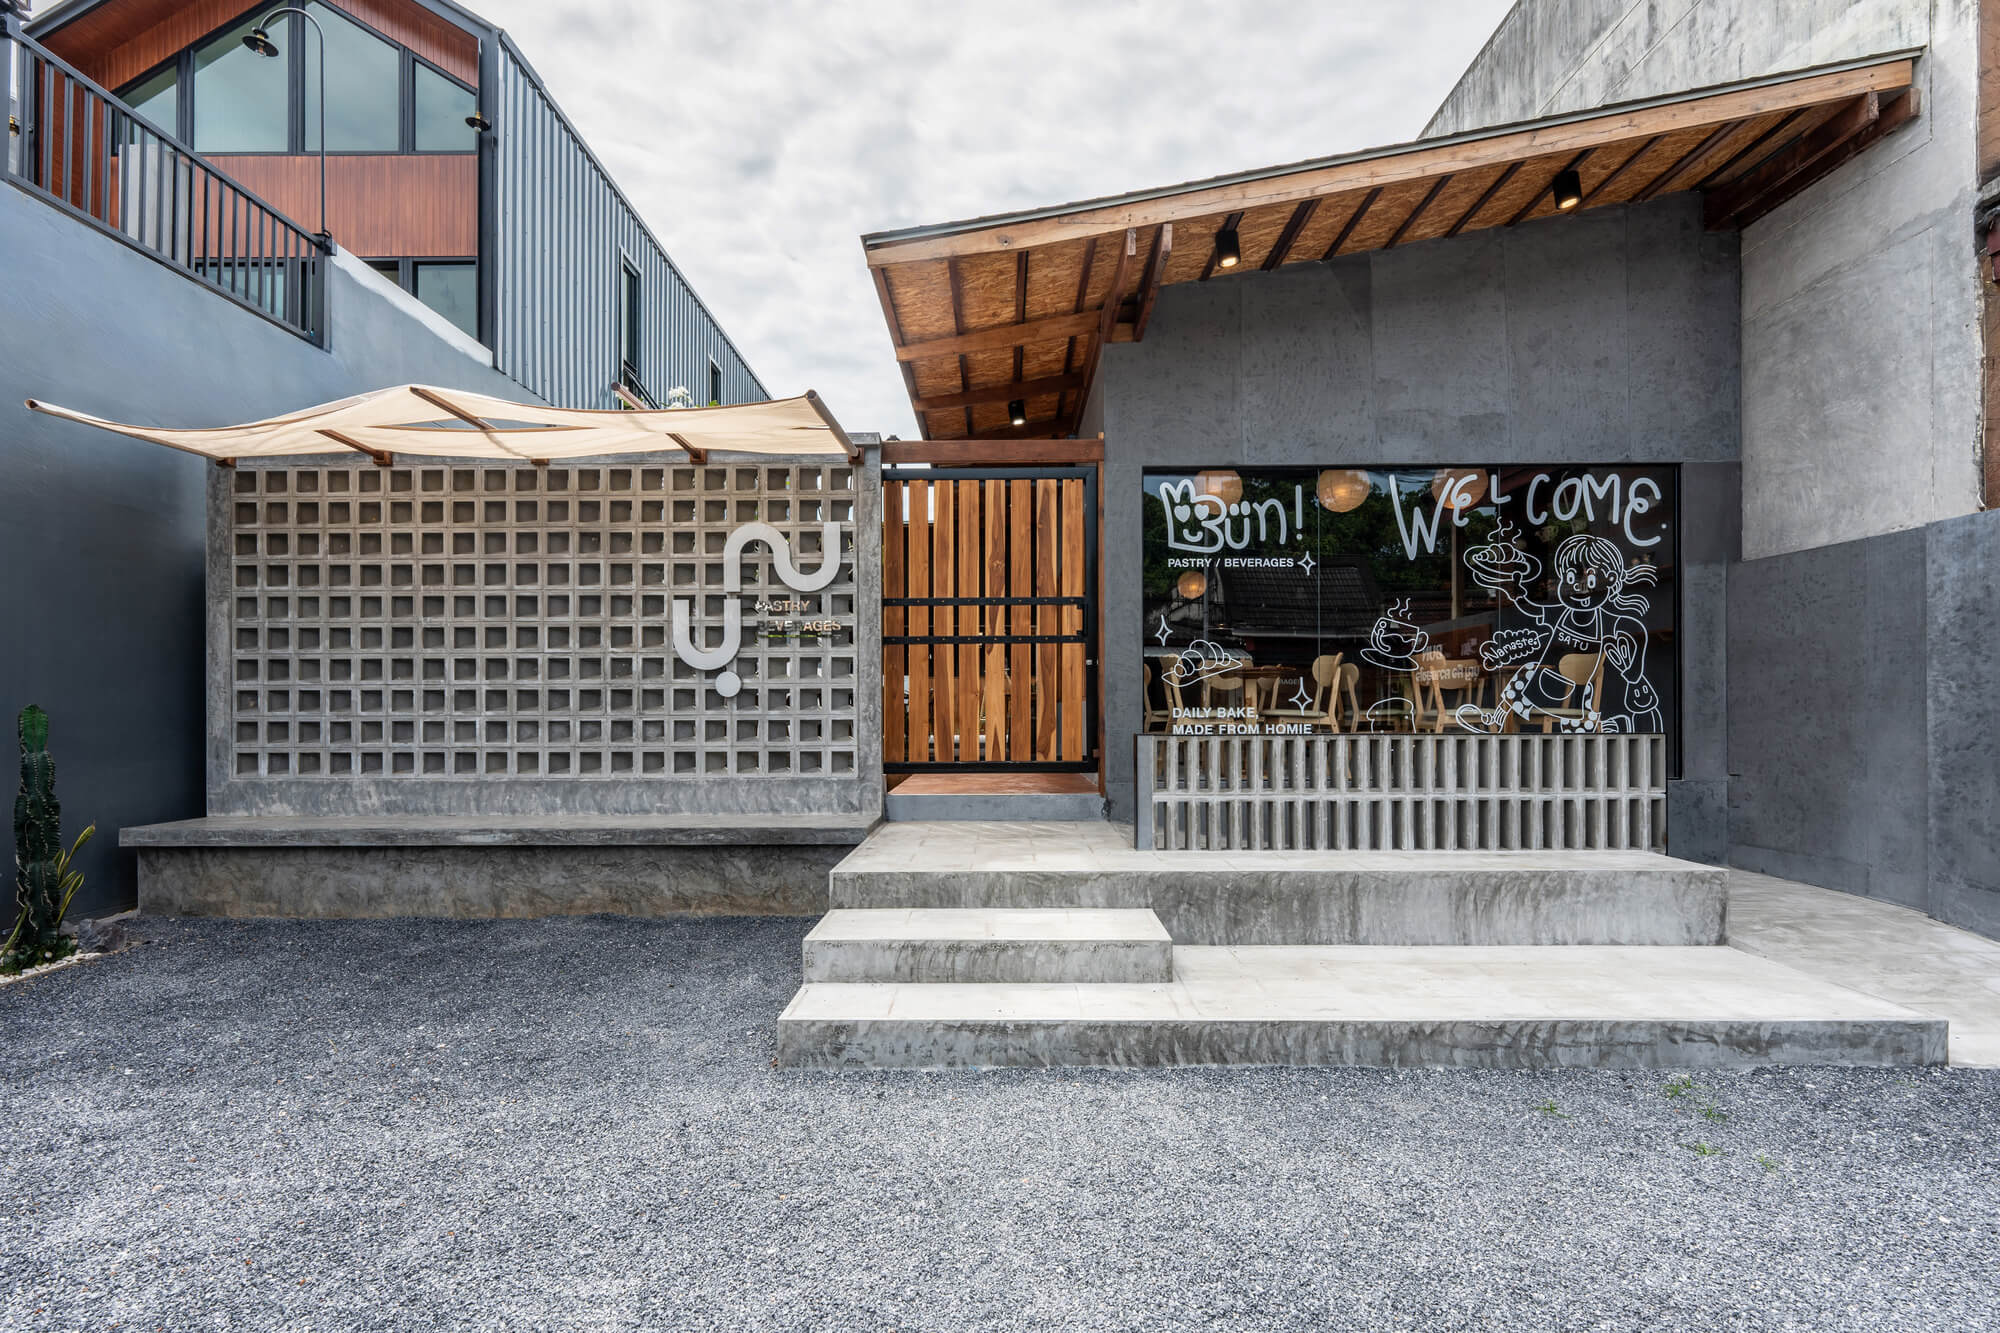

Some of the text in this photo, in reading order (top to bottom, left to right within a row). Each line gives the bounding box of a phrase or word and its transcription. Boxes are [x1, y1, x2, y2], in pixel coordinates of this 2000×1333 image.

[1167, 558, 1213, 568] PASTRY
[1224, 558, 1295, 568] BEVERAGES
[755, 600, 811, 612] PASTRY
[1558, 631, 1589, 651] SATU
[1172, 707, 1259, 720] DAILY BAKE,
[1172, 723, 1313, 735] MADE FROM HOMIE
